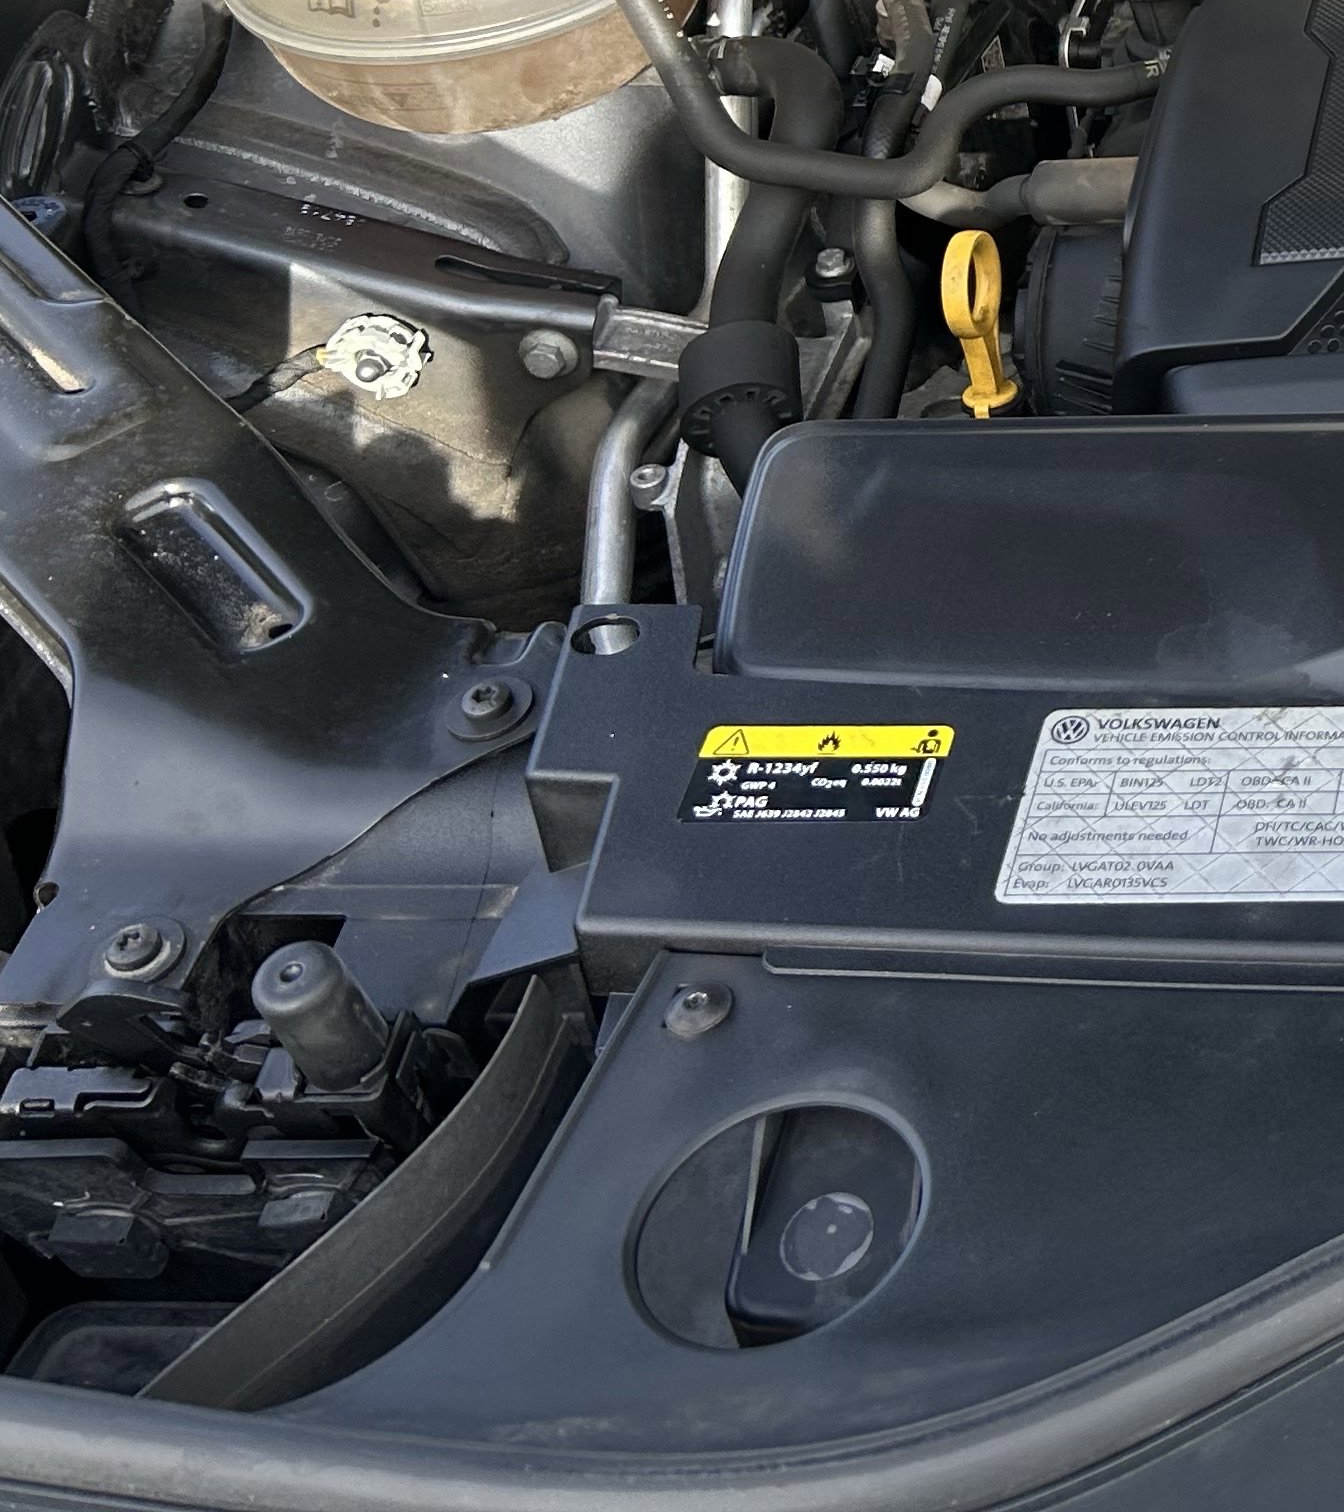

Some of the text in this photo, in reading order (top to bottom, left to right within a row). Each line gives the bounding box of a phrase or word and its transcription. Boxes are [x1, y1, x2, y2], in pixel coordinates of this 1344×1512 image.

[1099, 718, 1220, 729] VOLKSWAGEN
[1094, 732, 1147, 743] VEHICLE
[1150, 732, 1214, 742] EMISSION
[1218, 731, 1279, 741] CONTROL
[1050, 755, 1113, 765] Conforms
[1117, 756, 1130, 765] to
[1133, 755, 1211, 767] regulations:
[747, 762, 907, 776] R-1234yf 0.550 kg
[741, 781, 767, 790] GWP
[768, 781, 776, 789] 4
[1120, 778, 1163, 787] BIN125
[1190, 777, 1222, 787] LDT2
[1282, 776, 1299, 786] CA
[735, 796, 768, 807] PAG
[1037, 800, 1097, 810] California:
[1115, 801, 1167, 810] ULEV125
[1184, 800, 1210, 810] LDT
[1277, 799, 1295, 808] CA
[733, 810, 754, 818] SAE
[876, 808, 920, 817] VW AG
[1028, 831, 1046, 841] No
[1050, 830, 1134, 843] adjustments
[1018, 862, 1064, 873] Group:
[1013, 879, 1049, 890] Evap:
